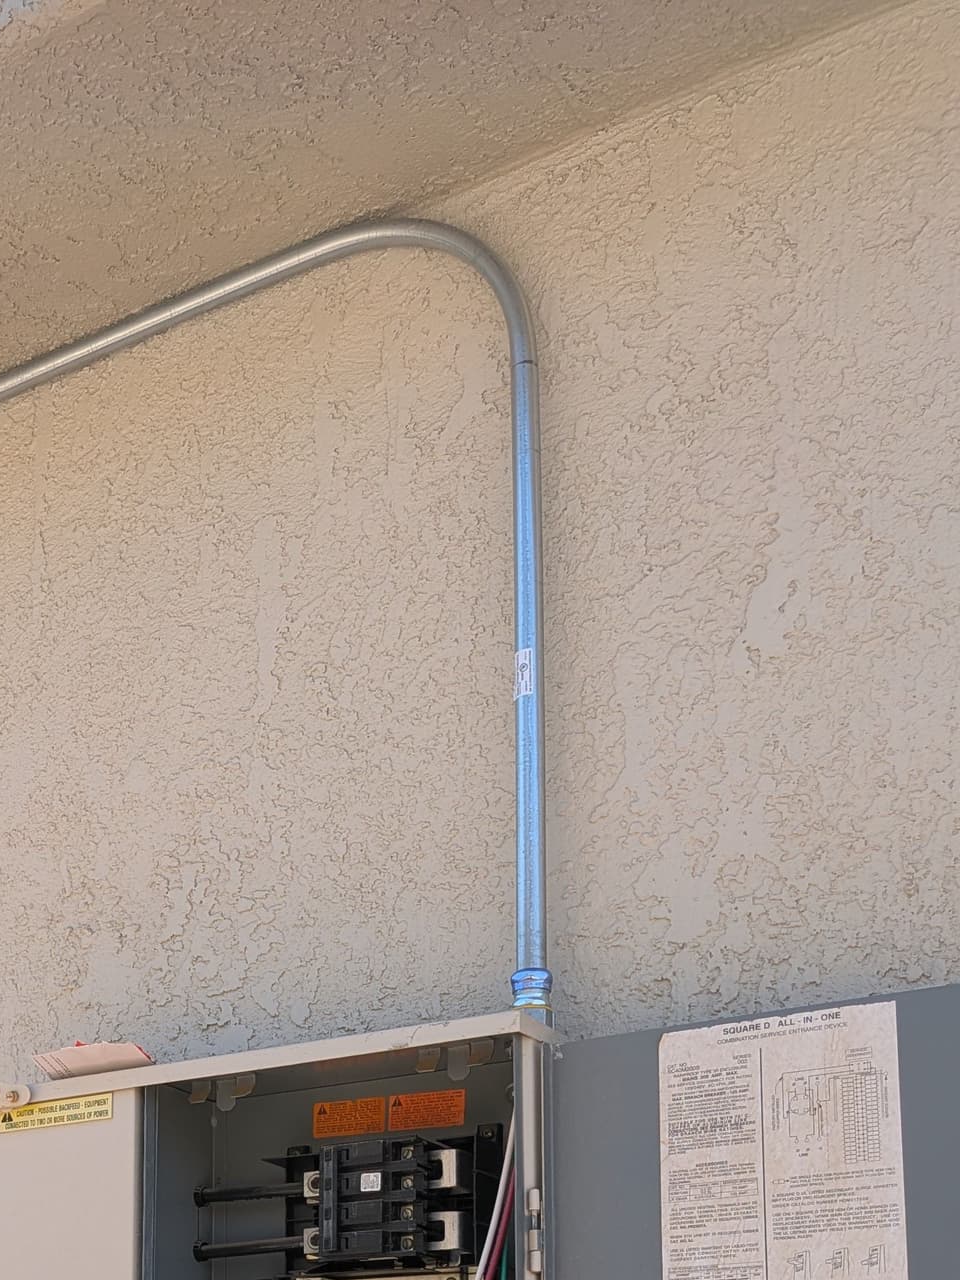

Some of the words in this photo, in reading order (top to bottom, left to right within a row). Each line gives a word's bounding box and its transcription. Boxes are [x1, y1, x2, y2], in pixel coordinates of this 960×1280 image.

[717, 1034, 759, 1045] COMBINATION
[760, 1030, 787, 1039] SERVICE
[788, 1025, 821, 1035] ENTRANCE
[824, 1022, 848, 1030] DEVICE
[723, 1024, 760, 1035] SQUARE
[803, 1016, 812, 1024] IN
[821, 1012, 840, 1021] ONE
[16, 1109, 34, 1118] CAUTION
[38, 1105, 58, 1115] POSSIBLE
[59, 1102, 80, 1112] BACKFEED
[84, 1098, 109, 1108] EQUIPMENT
[5, 1121, 29, 1130] CONNECTED
[37, 1118, 45, 1126] TWO
[54, 1115, 65, 1123] MORE
[66, 1112, 85, 1122] SOURCES
[87, 1111, 92, 1119] OF
[93, 1109, 109, 1118] POWER
